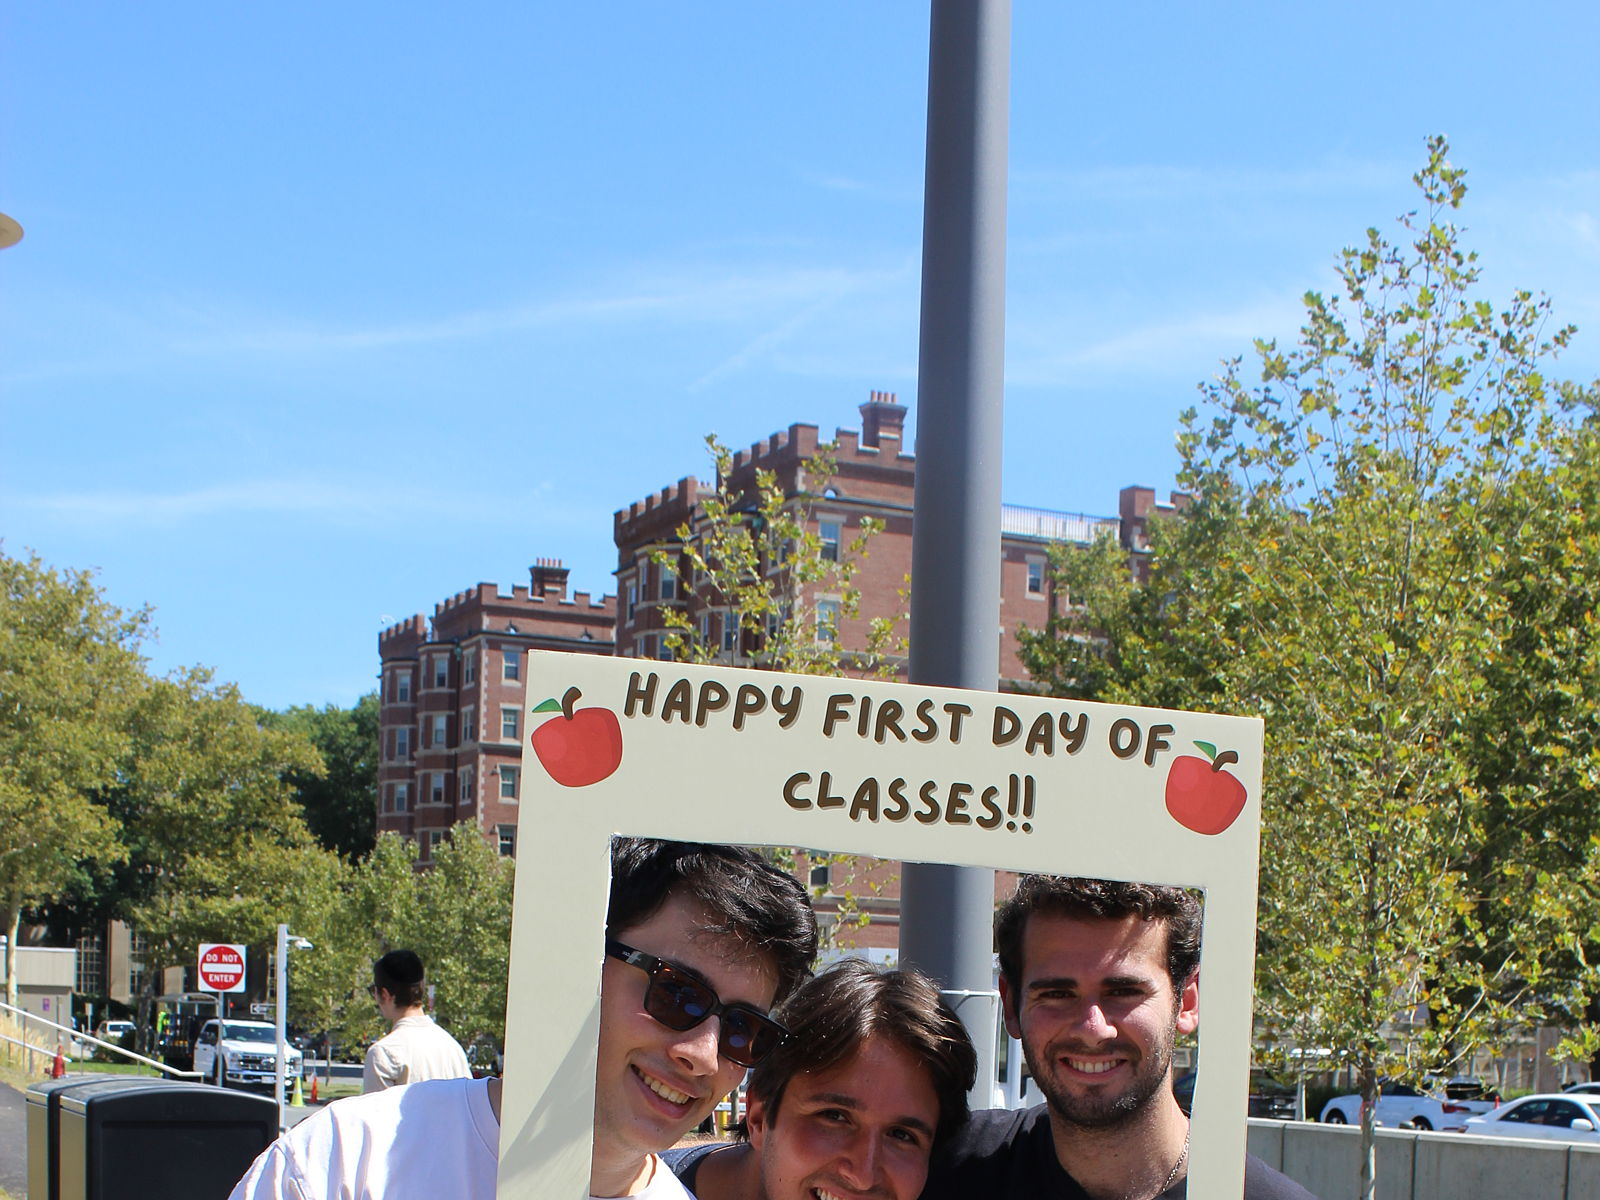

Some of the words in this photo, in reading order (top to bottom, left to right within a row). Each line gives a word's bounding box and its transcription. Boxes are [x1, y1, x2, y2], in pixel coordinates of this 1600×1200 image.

[623, 671, 804, 731] HAPPY
[822, 693, 973, 746] FIRST
[992, 702, 1090, 757] DAY
[1108, 717, 1178, 768] OF
[782, 771, 1038, 834] CLASSES!!
[206, 954, 218, 962] DO
[222, 954, 238, 962] NOT
[208, 974, 235, 983] ENTER
